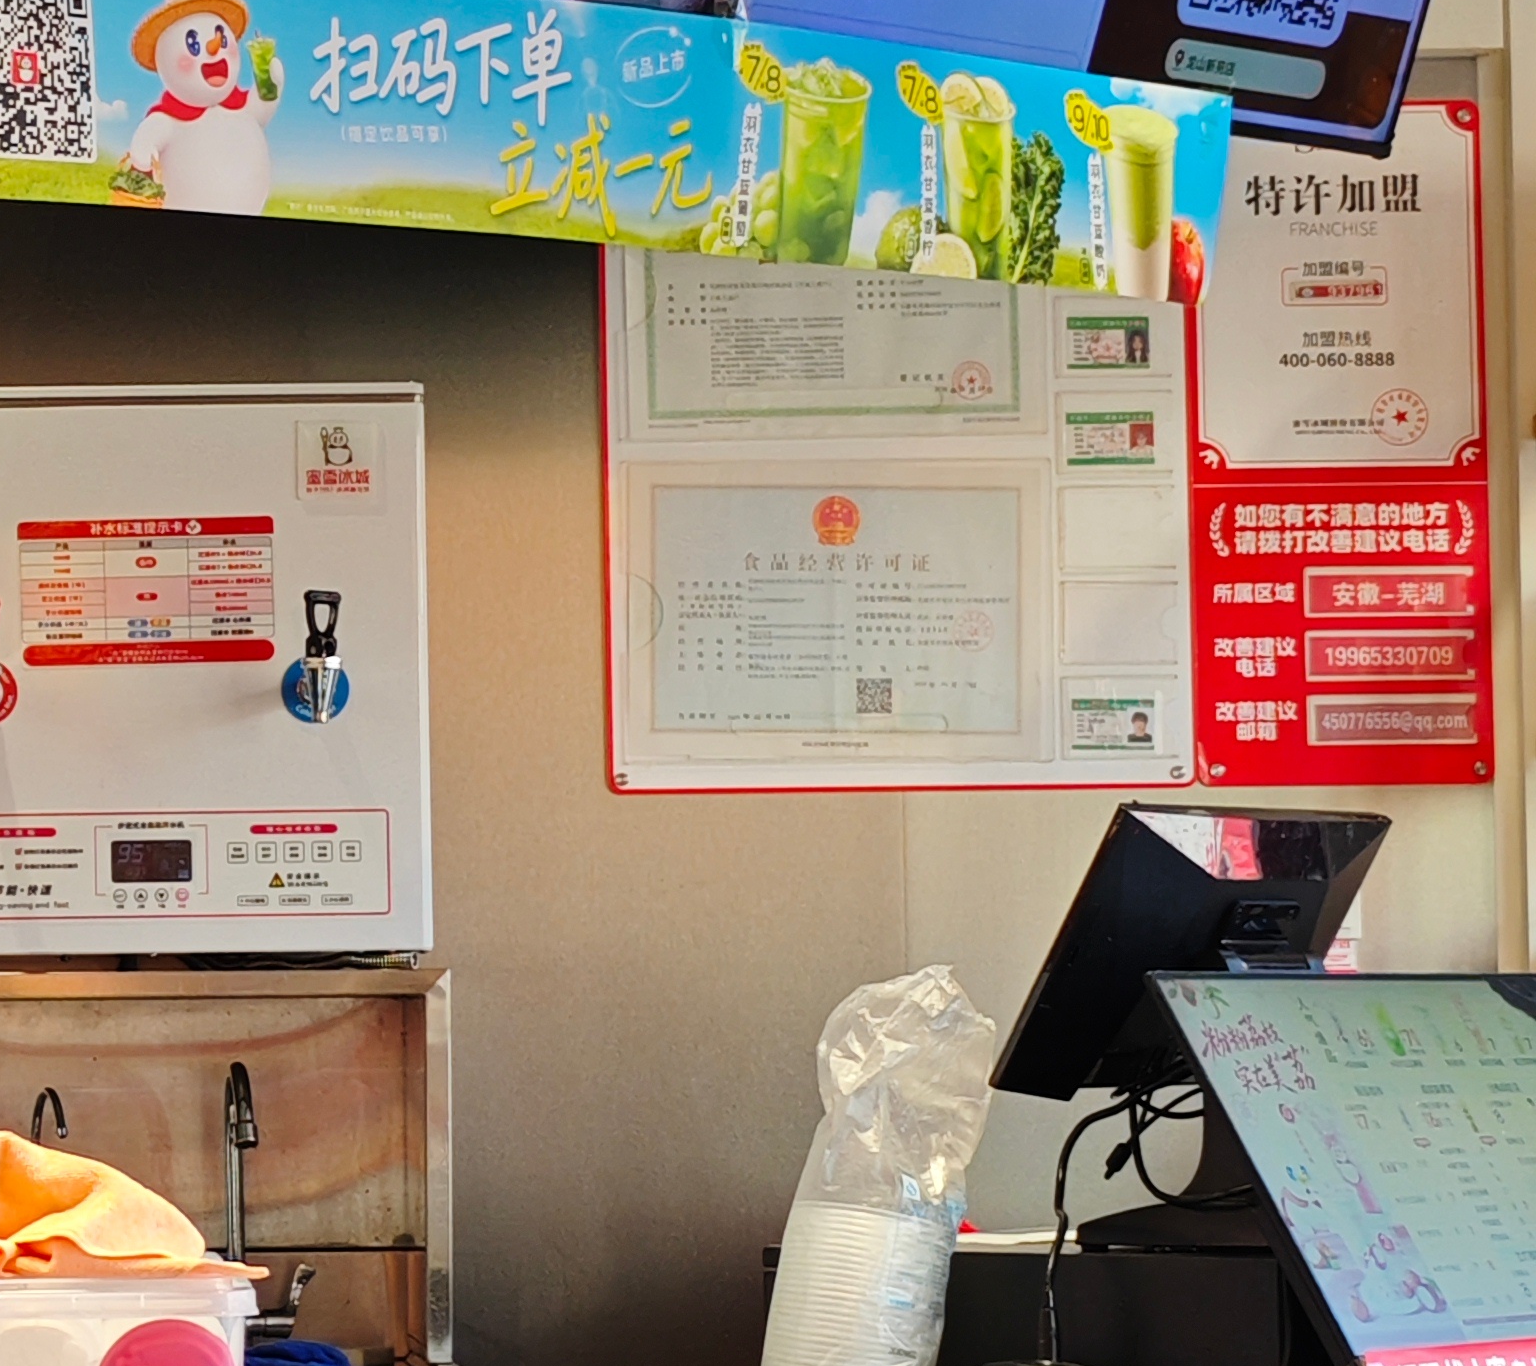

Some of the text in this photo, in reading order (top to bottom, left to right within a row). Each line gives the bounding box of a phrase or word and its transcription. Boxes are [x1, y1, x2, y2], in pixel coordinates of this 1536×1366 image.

[310, 9, 574, 127] 扫码下单
[621, 47, 687, 85] 新品上市
[490, 112, 714, 237] 立减一元
[1244, 172, 1423, 217] 特许加盟
[1289, 221, 1379, 237] FRANCHISE
[1302, 260, 1365, 277] 加盟编号
[1302, 331, 1373, 348] 加盟热线
[1278, 351, 1396, 368] 400-060-8888
[1233, 502, 1450, 529] 如您有不满意的地方
[1234, 529, 1451, 555] 请拨打改善建议电话
[743, 551, 932, 573] 食品经营许可证
[1212, 582, 1296, 605] 所属区域
[1332, 581, 1446, 607] 安徽-芜湖
[1213, 636, 1298, 658] 改善建议
[1324, 645, 1454, 668] 19965330709
[1235, 657, 1277, 678] 电话
[1215, 700, 1299, 723] 改善建议
[1235, 721, 1279, 742] 邮箱
